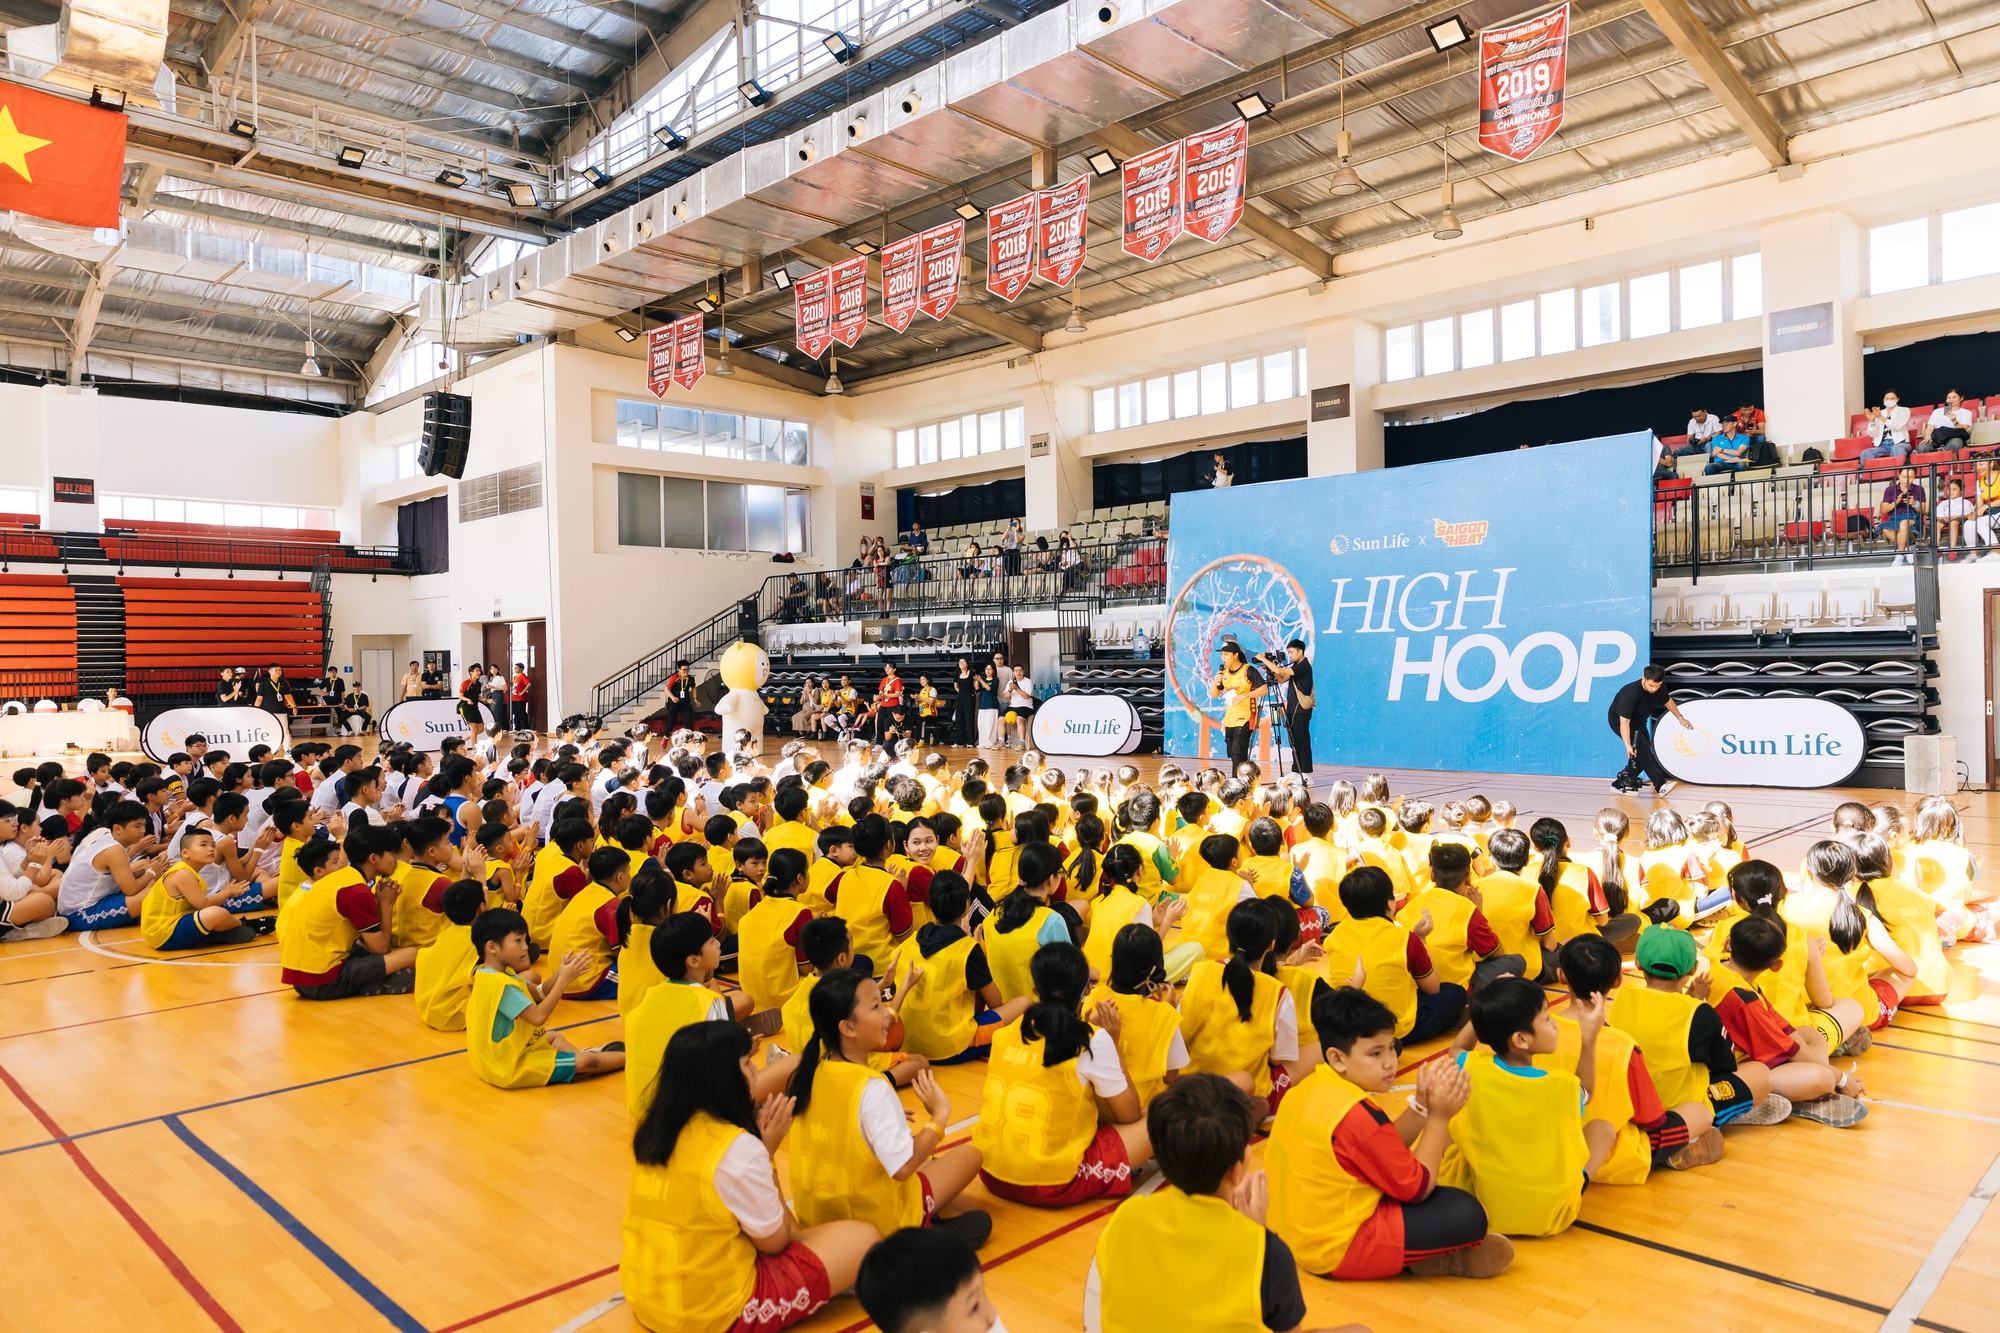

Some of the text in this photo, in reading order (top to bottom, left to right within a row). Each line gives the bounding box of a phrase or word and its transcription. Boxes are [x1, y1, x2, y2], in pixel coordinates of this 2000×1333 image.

[1497, 63, 1550, 104] 2019
[1494, 104, 1518, 119] SISAC
[1518, 97, 1545, 111] POOL
[1497, 109, 1550, 130] CHAMPIONS
[1197, 164, 1236, 196] 2019
[1135, 186, 1170, 218] 2019
[1197, 200, 1236, 218] CHAMPIONS
[1049, 215, 1079, 245] 2019
[1137, 221, 1169, 238] CHAMPIONS
[998, 233, 1027, 260] 2018
[1049, 248, 1080, 264] CHAMPIONS
[928, 257, 954, 282] 2018
[889, 270, 913, 295] 2018
[839, 288, 862, 311] 2018
[802, 302, 824, 323] 2018
[1776, 322, 1818, 336] STANDARD
[653, 350, 669, 368] 2018
[680, 341, 698, 360] 2018
[1315, 398, 1341, 408] STANDARD
[55, 482, 93, 493] HEAT ZONE
[1435, 520, 1488, 537] SAIGON
[1352, 537, 1380, 551] Sun
[1383, 533, 1410, 549] Life
[1447, 533, 1486, 547] HEAT
[1322, 567, 1517, 634] HIGH
[1387, 630, 1637, 703] HOOP
[235, 728, 270, 743] Life
[425, 720, 455, 733] Sun
[1063, 719, 1121, 735] Sun Life
[1721, 732, 1842, 756] Sun Life
[1191, 909, 1211, 937] 7
[1030, 1052, 1039, 1067] 1
